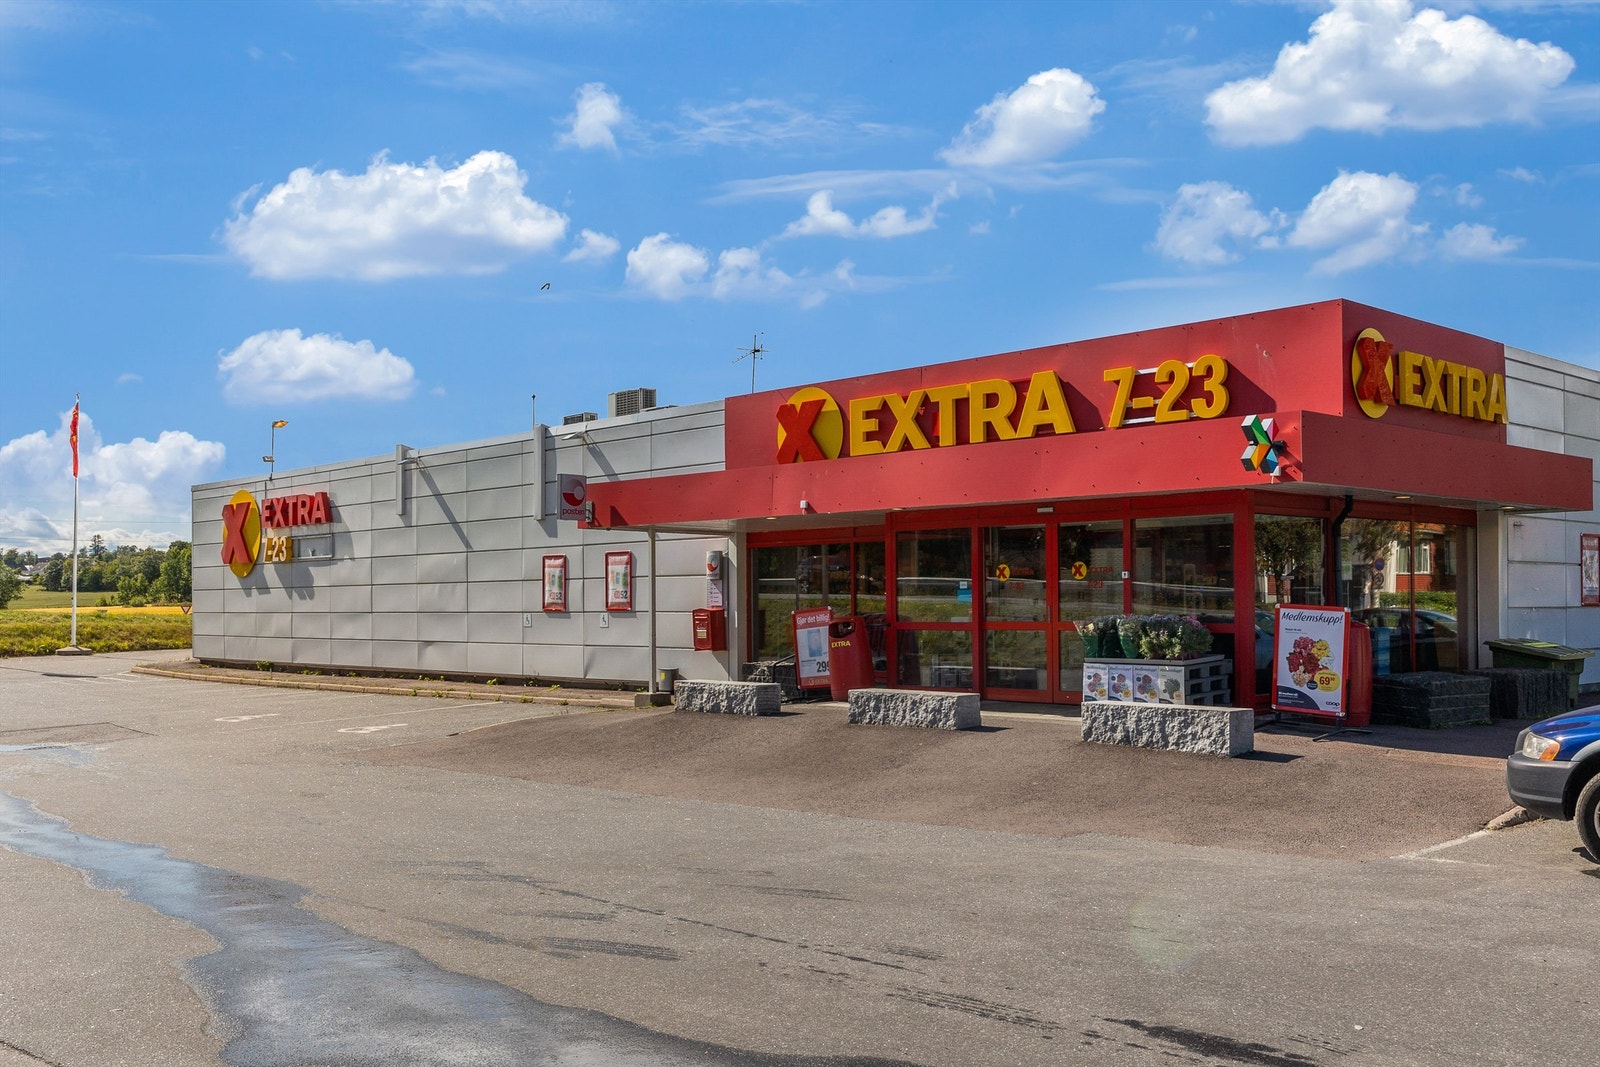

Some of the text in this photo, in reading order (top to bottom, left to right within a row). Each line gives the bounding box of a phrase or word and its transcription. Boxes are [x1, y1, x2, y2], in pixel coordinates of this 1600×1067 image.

[1399, 351, 1509, 424] EXTRA
[849, 370, 1076, 457] EXTRA
[1104, 354, 1229, 428] 7-23
[261, 492, 333, 528] EXTRA
[563, 508, 584, 516] posten
[262, 535, 292, 563] 7-23
[1281, 611, 1343, 626] Medlemskupp!
[1319, 676, 1330, 685] 69
